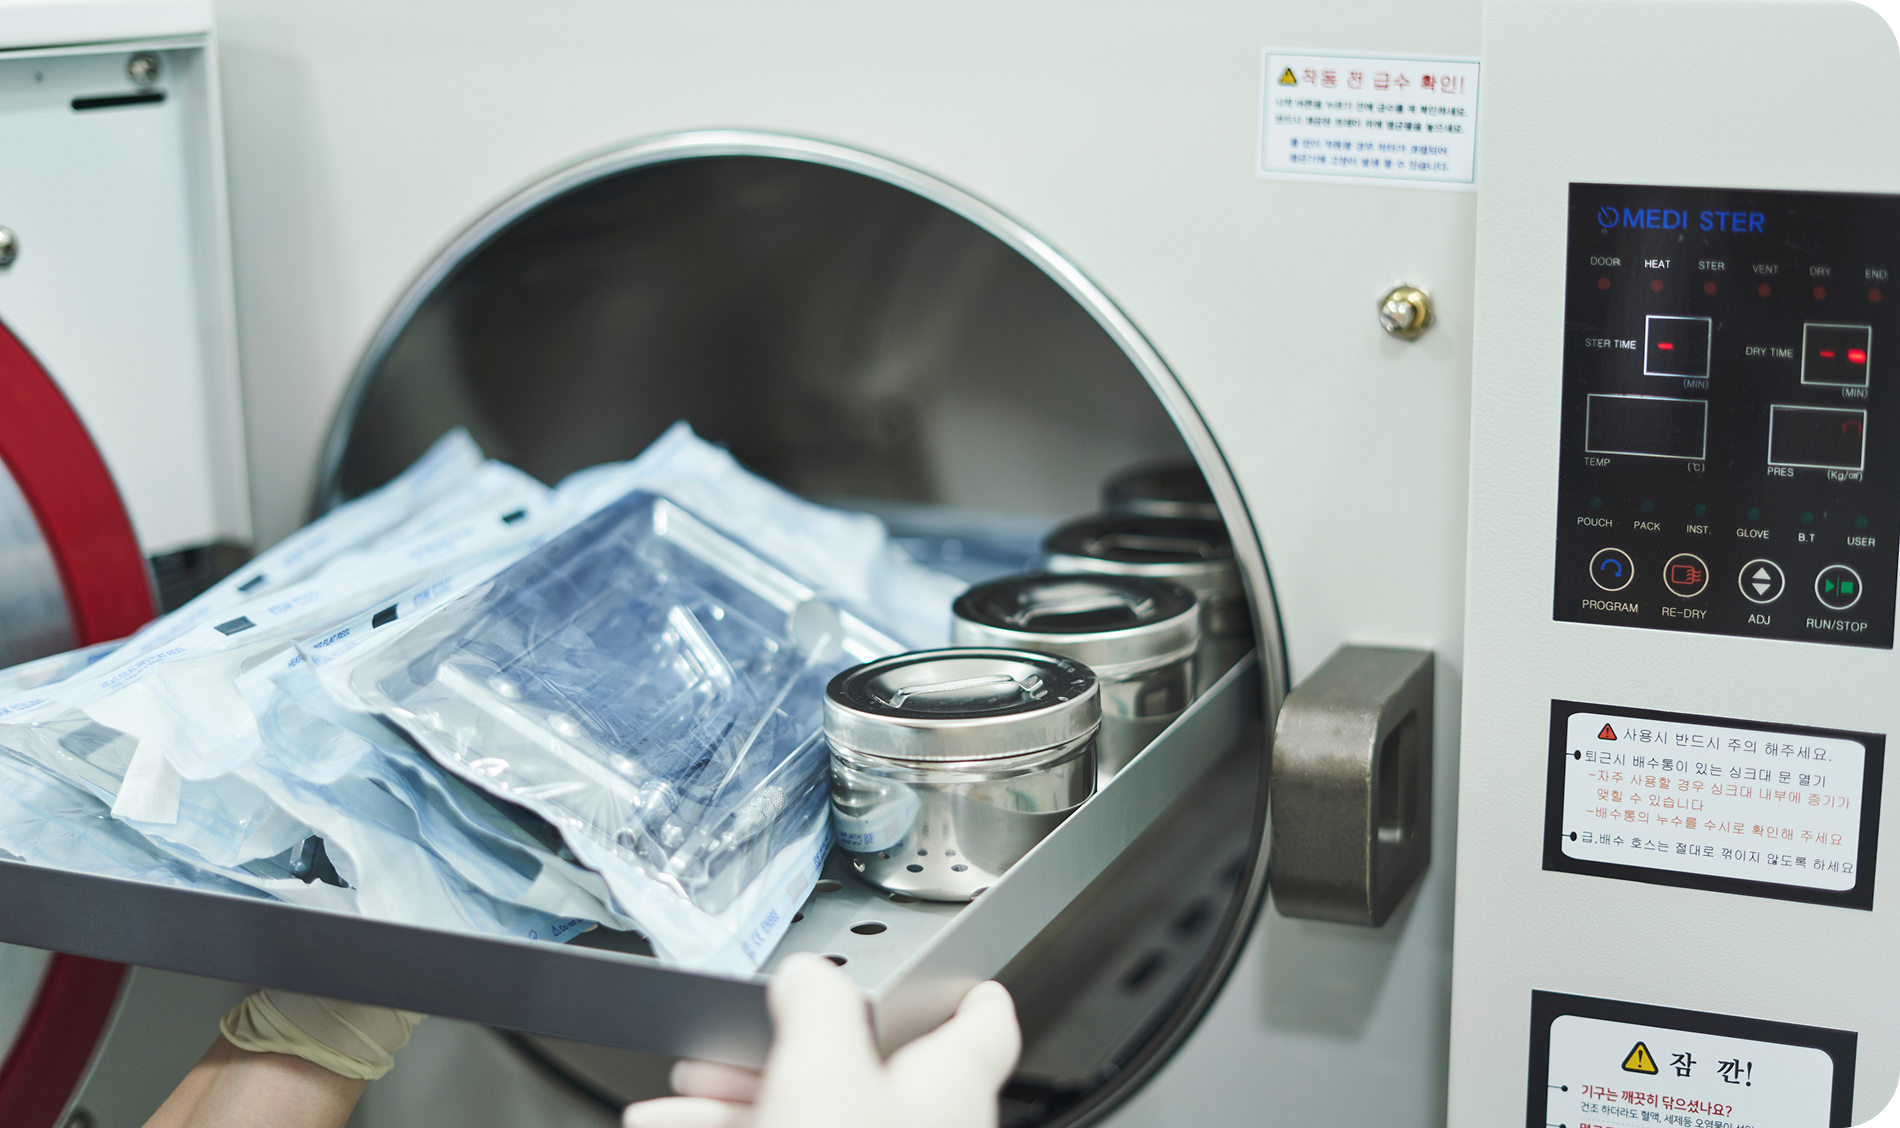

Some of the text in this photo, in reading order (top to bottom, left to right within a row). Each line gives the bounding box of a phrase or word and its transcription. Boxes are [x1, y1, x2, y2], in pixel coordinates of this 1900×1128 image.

[1302, 68, 1337, 88] 작동
[1374, 73, 1410, 90] 급수
[1623, 208, 1765, 232] MEDI STER
[1591, 257, 1621, 266] DOOR
[1645, 260, 1670, 268] HEAT
[1699, 261, 1724, 270] STER
[1753, 265, 1778, 274] VENT
[1810, 267, 1830, 276] DRY
[1865, 270, 1887, 279] END
[1585, 339, 1636, 349] STER TIME
[1746, 347, 1793, 358] DRY TIME
[1683, 379, 1709, 391] (MIN)
[1841, 388, 1868, 399] (MIN)
[1584, 457, 1610, 466] TEMP
[1767, 466, 1794, 478] PRES
[1577, 517, 1612, 527] POUCH
[1634, 521, 1660, 530] PACK
[1686, 524, 1712, 535] INST.
[1737, 528, 1769, 539] GLOVE
[1798, 533, 1815, 542] B.T
[1847, 537, 1875, 546] USER
[1583, 599, 1638, 612] PROGRAM
[1662, 607, 1706, 619] RE-DRY
[1748, 614, 1770, 625] ADJ
[1807, 618, 1867, 631] RUN/STOP
[1624, 728, 1831, 761] 사용시 반드시 주의 해주세요.
[1585, 751, 1825, 788] 퇴근시 배수통이 있는 싱크대 문 열기
[1630, 775, 1670, 789] 사용할
[1678, 779, 1704, 792] 경우
[1711, 783, 1752, 798] 싱크대
[1759, 789, 1800, 804] 내부에
[1808, 794, 1850, 809] 증기가
[1598, 788, 1703, 811] 맺힐 수 있습니다
[1657, 814, 1697, 829] 누수를
[1704, 820, 1744, 834] 수시로
[1752, 825, 1793, 840] 확인해
[1801, 830, 1842, 845] 주세요
[1631, 838, 1669, 852] 호스는
[1676, 843, 1714, 857] 절대로
[1722, 848, 1759, 863] 꺾이지
[1767, 853, 1806, 868] 않도록
[1814, 859, 1853, 873] 하세요
[1670, 1052, 1752, 1087] 잠 깐!
[1581, 1085, 1733, 1118] 기구는 깨끗히 닦으셨나요?
[1581, 1102, 1598, 1113] 건조
[1602, 1103, 1639, 1118] 하더라도
[1641, 1111, 1661, 1123] 혈액,
[1664, 1115, 1692, 1127] 세제등
